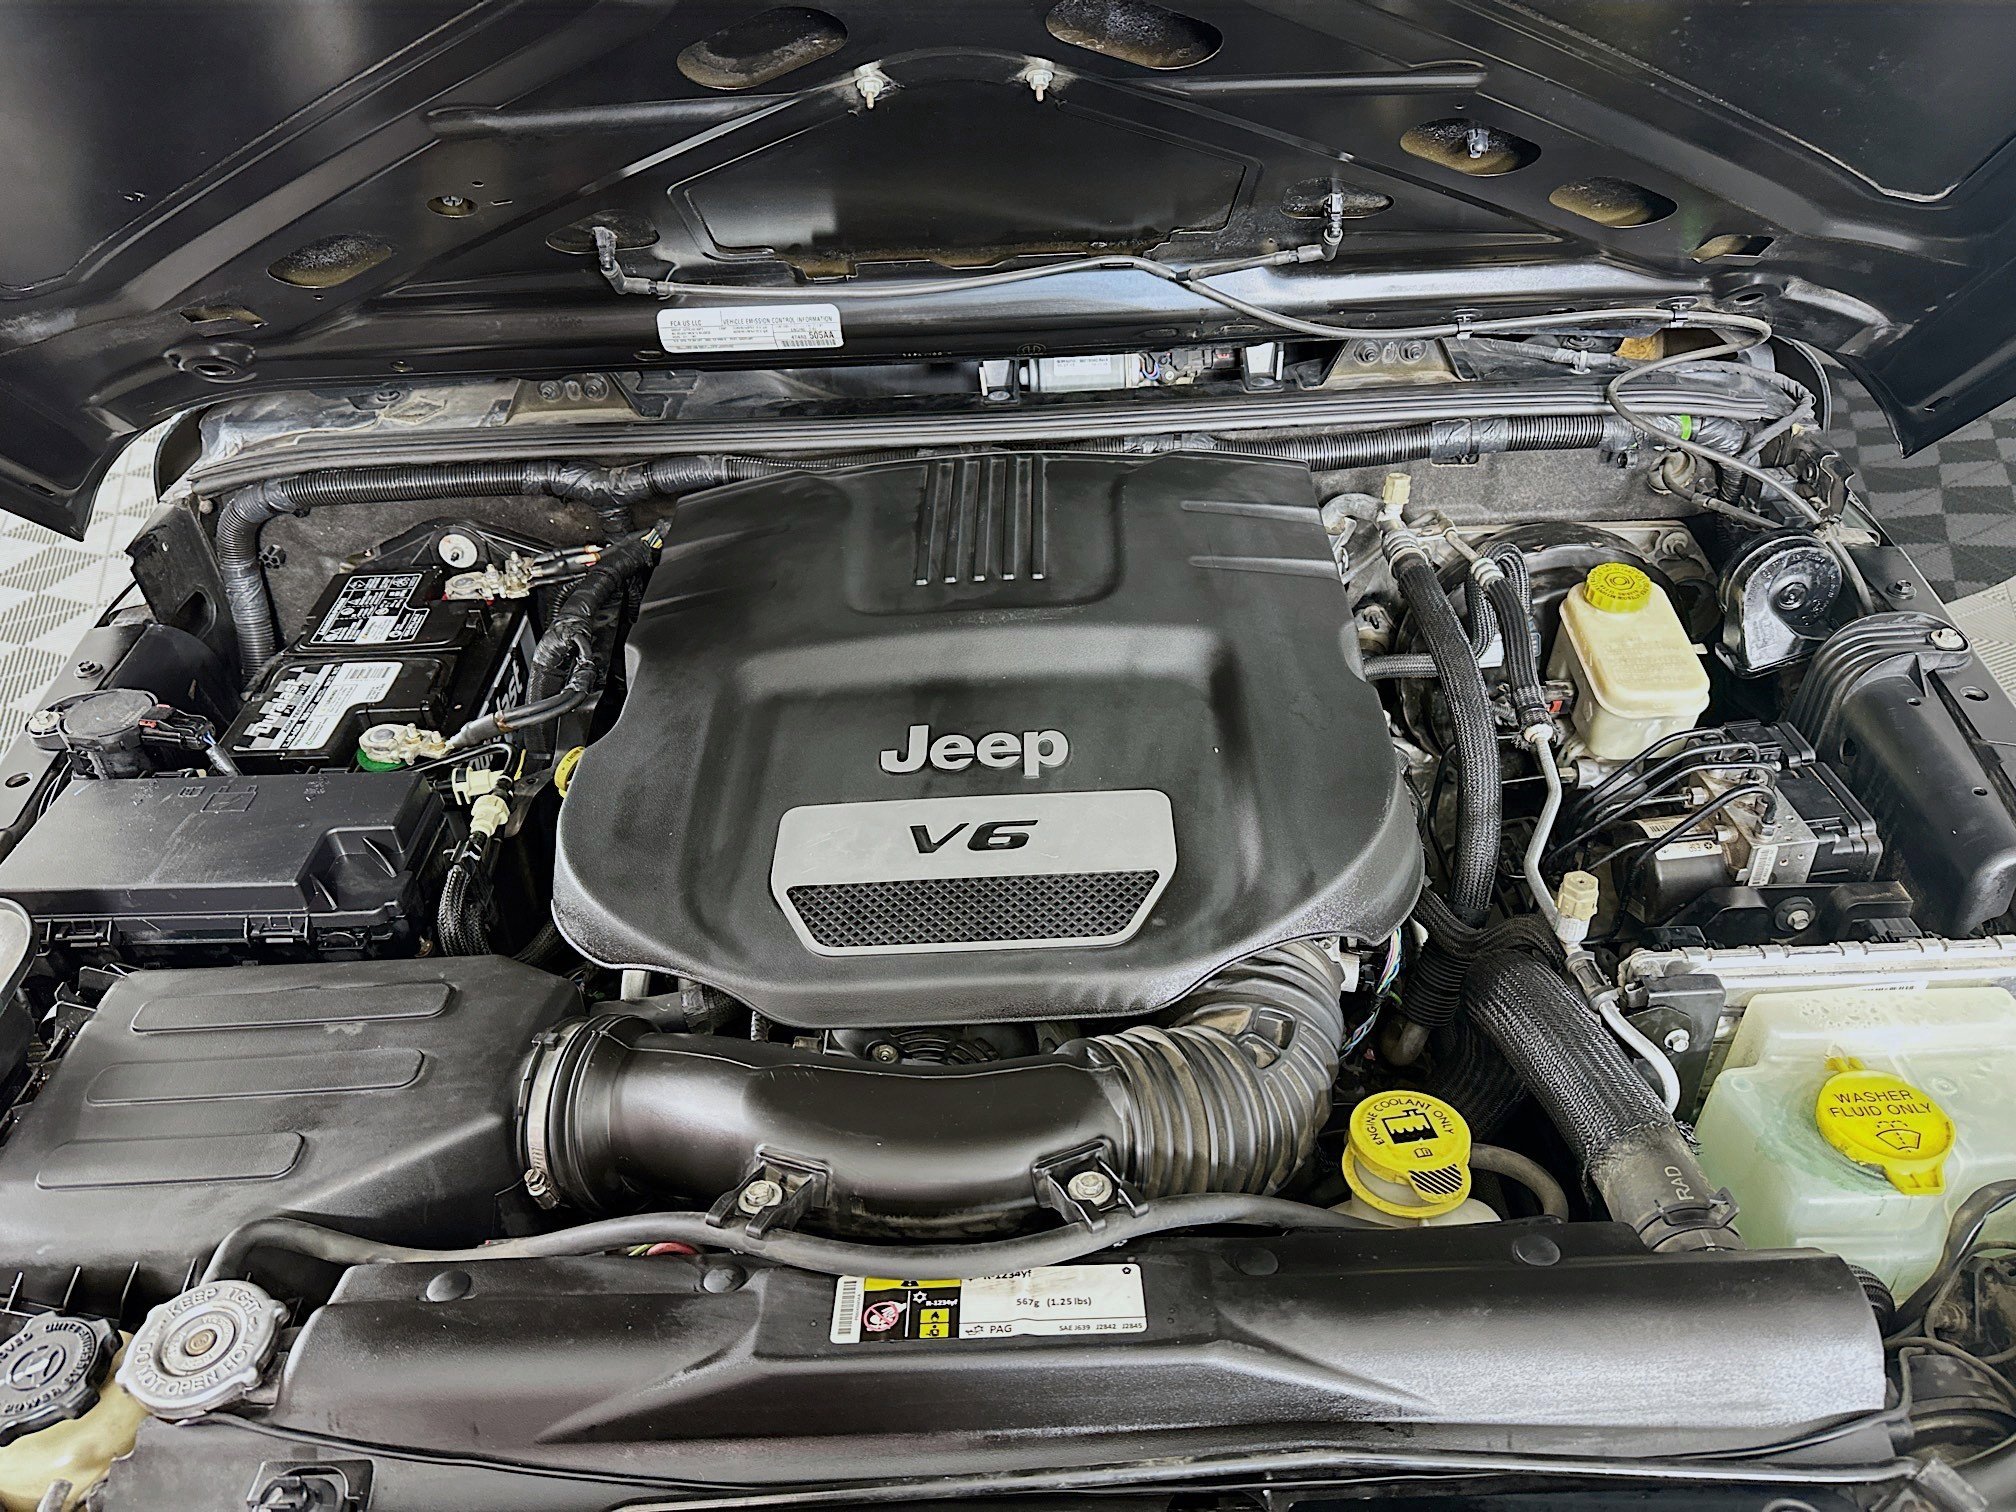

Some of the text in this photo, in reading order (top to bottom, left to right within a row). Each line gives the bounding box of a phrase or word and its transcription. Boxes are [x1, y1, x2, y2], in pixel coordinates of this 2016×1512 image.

[745, 317, 771, 325] EMISSION
[809, 330, 835, 339] 505AA
[880, 724, 1069, 778] Jeep
[909, 818, 1039, 854] V6
[1834, 1089, 1914, 1104] WASHER
[1365, 1098, 1455, 1147] ENGINE COOLANT ONLY
[1829, 1102, 1933, 1118] FLUID ONLY
[1664, 1165, 1695, 1201] RAD
[168, 1286, 262, 1320] KEEP TIGHT
[1016, 1297, 1092, 1308] 567g (1.25 lbs)
[989, 1324, 1012, 1334] PAG
[136, 1367, 167, 1394] NOT
[165, 1370, 219, 1396] OPEN
[222, 1340, 255, 1377] HOT
[4, 1388, 62, 1414] POWER
